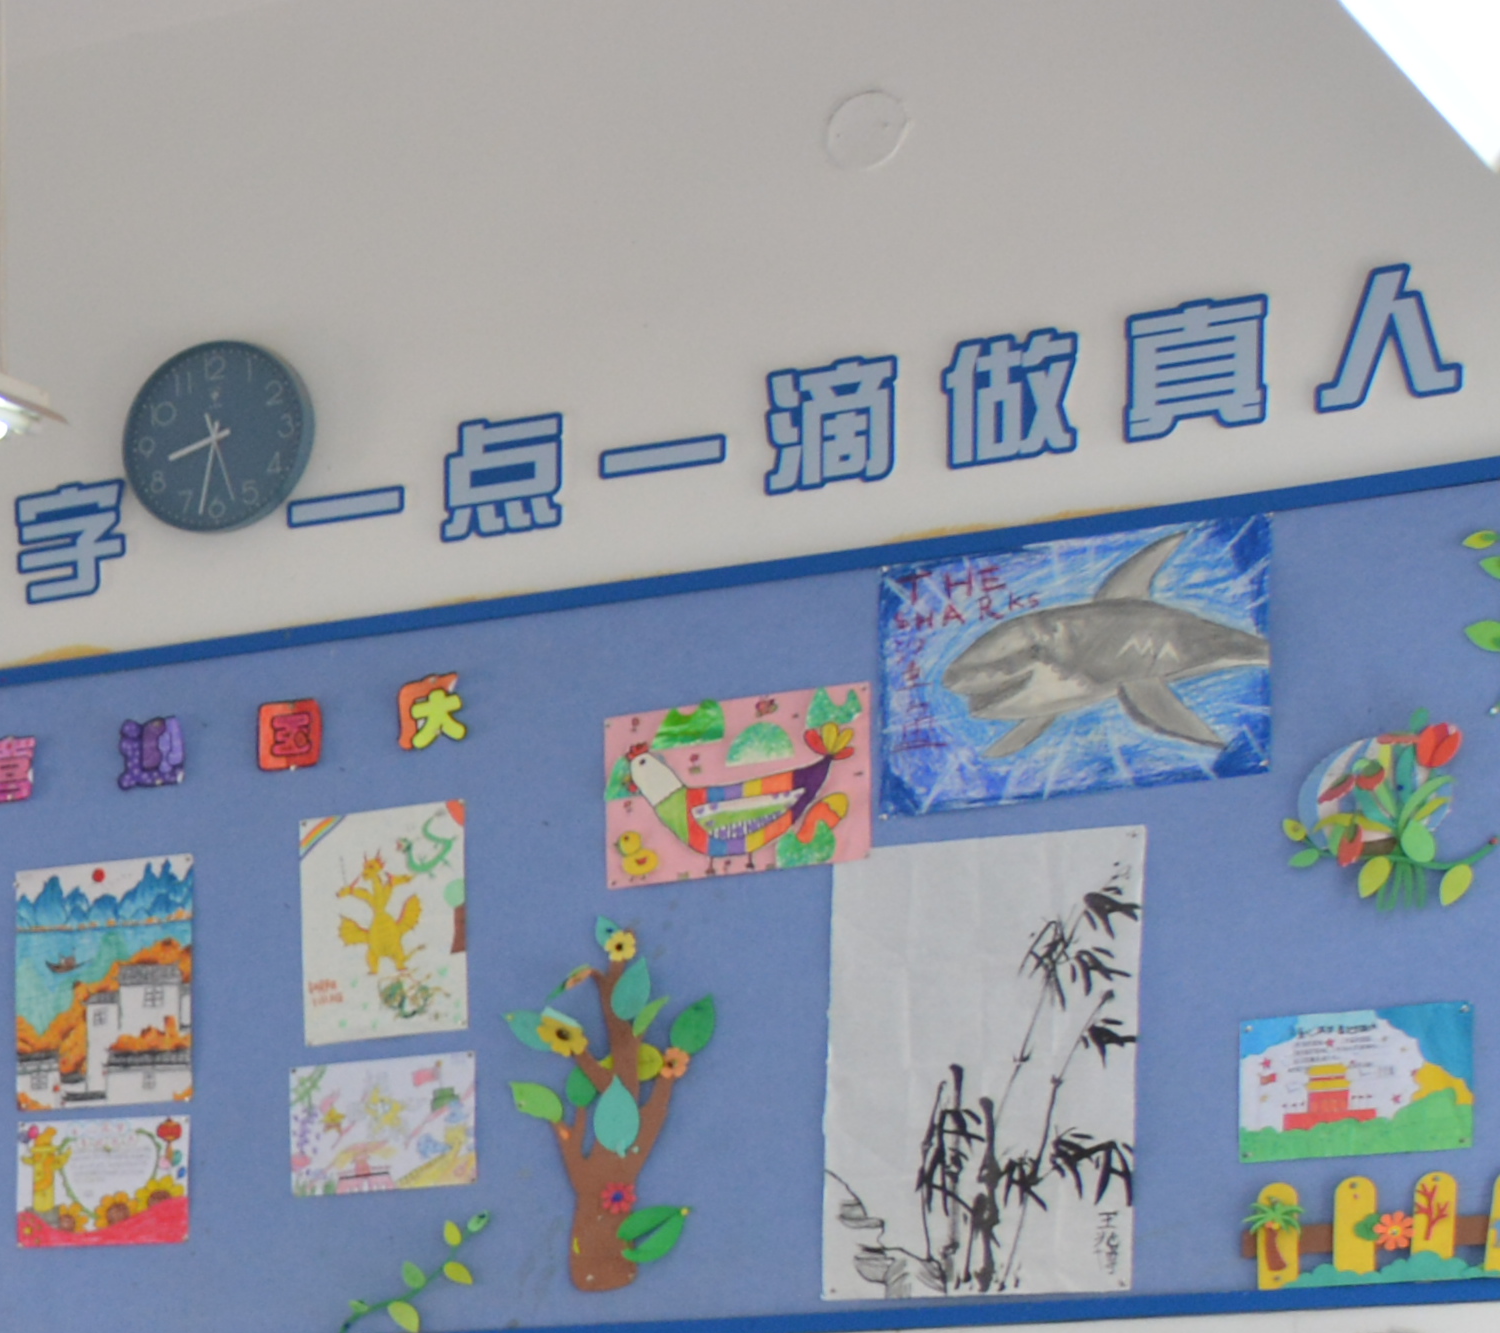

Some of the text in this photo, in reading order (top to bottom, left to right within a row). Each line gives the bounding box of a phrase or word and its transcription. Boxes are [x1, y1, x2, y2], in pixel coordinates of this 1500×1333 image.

[203, 355, 227, 382] 12
[264, 379, 284, 406] 2
[287, 263, 1464, 542] 一点一滴做真人
[277, 412, 295, 438] 3
[266, 451, 283, 474] 4
[150, 470, 167, 494] 8
[896, 565, 1007, 605] THE
[894, 592, 1041, 630] SHARKS
